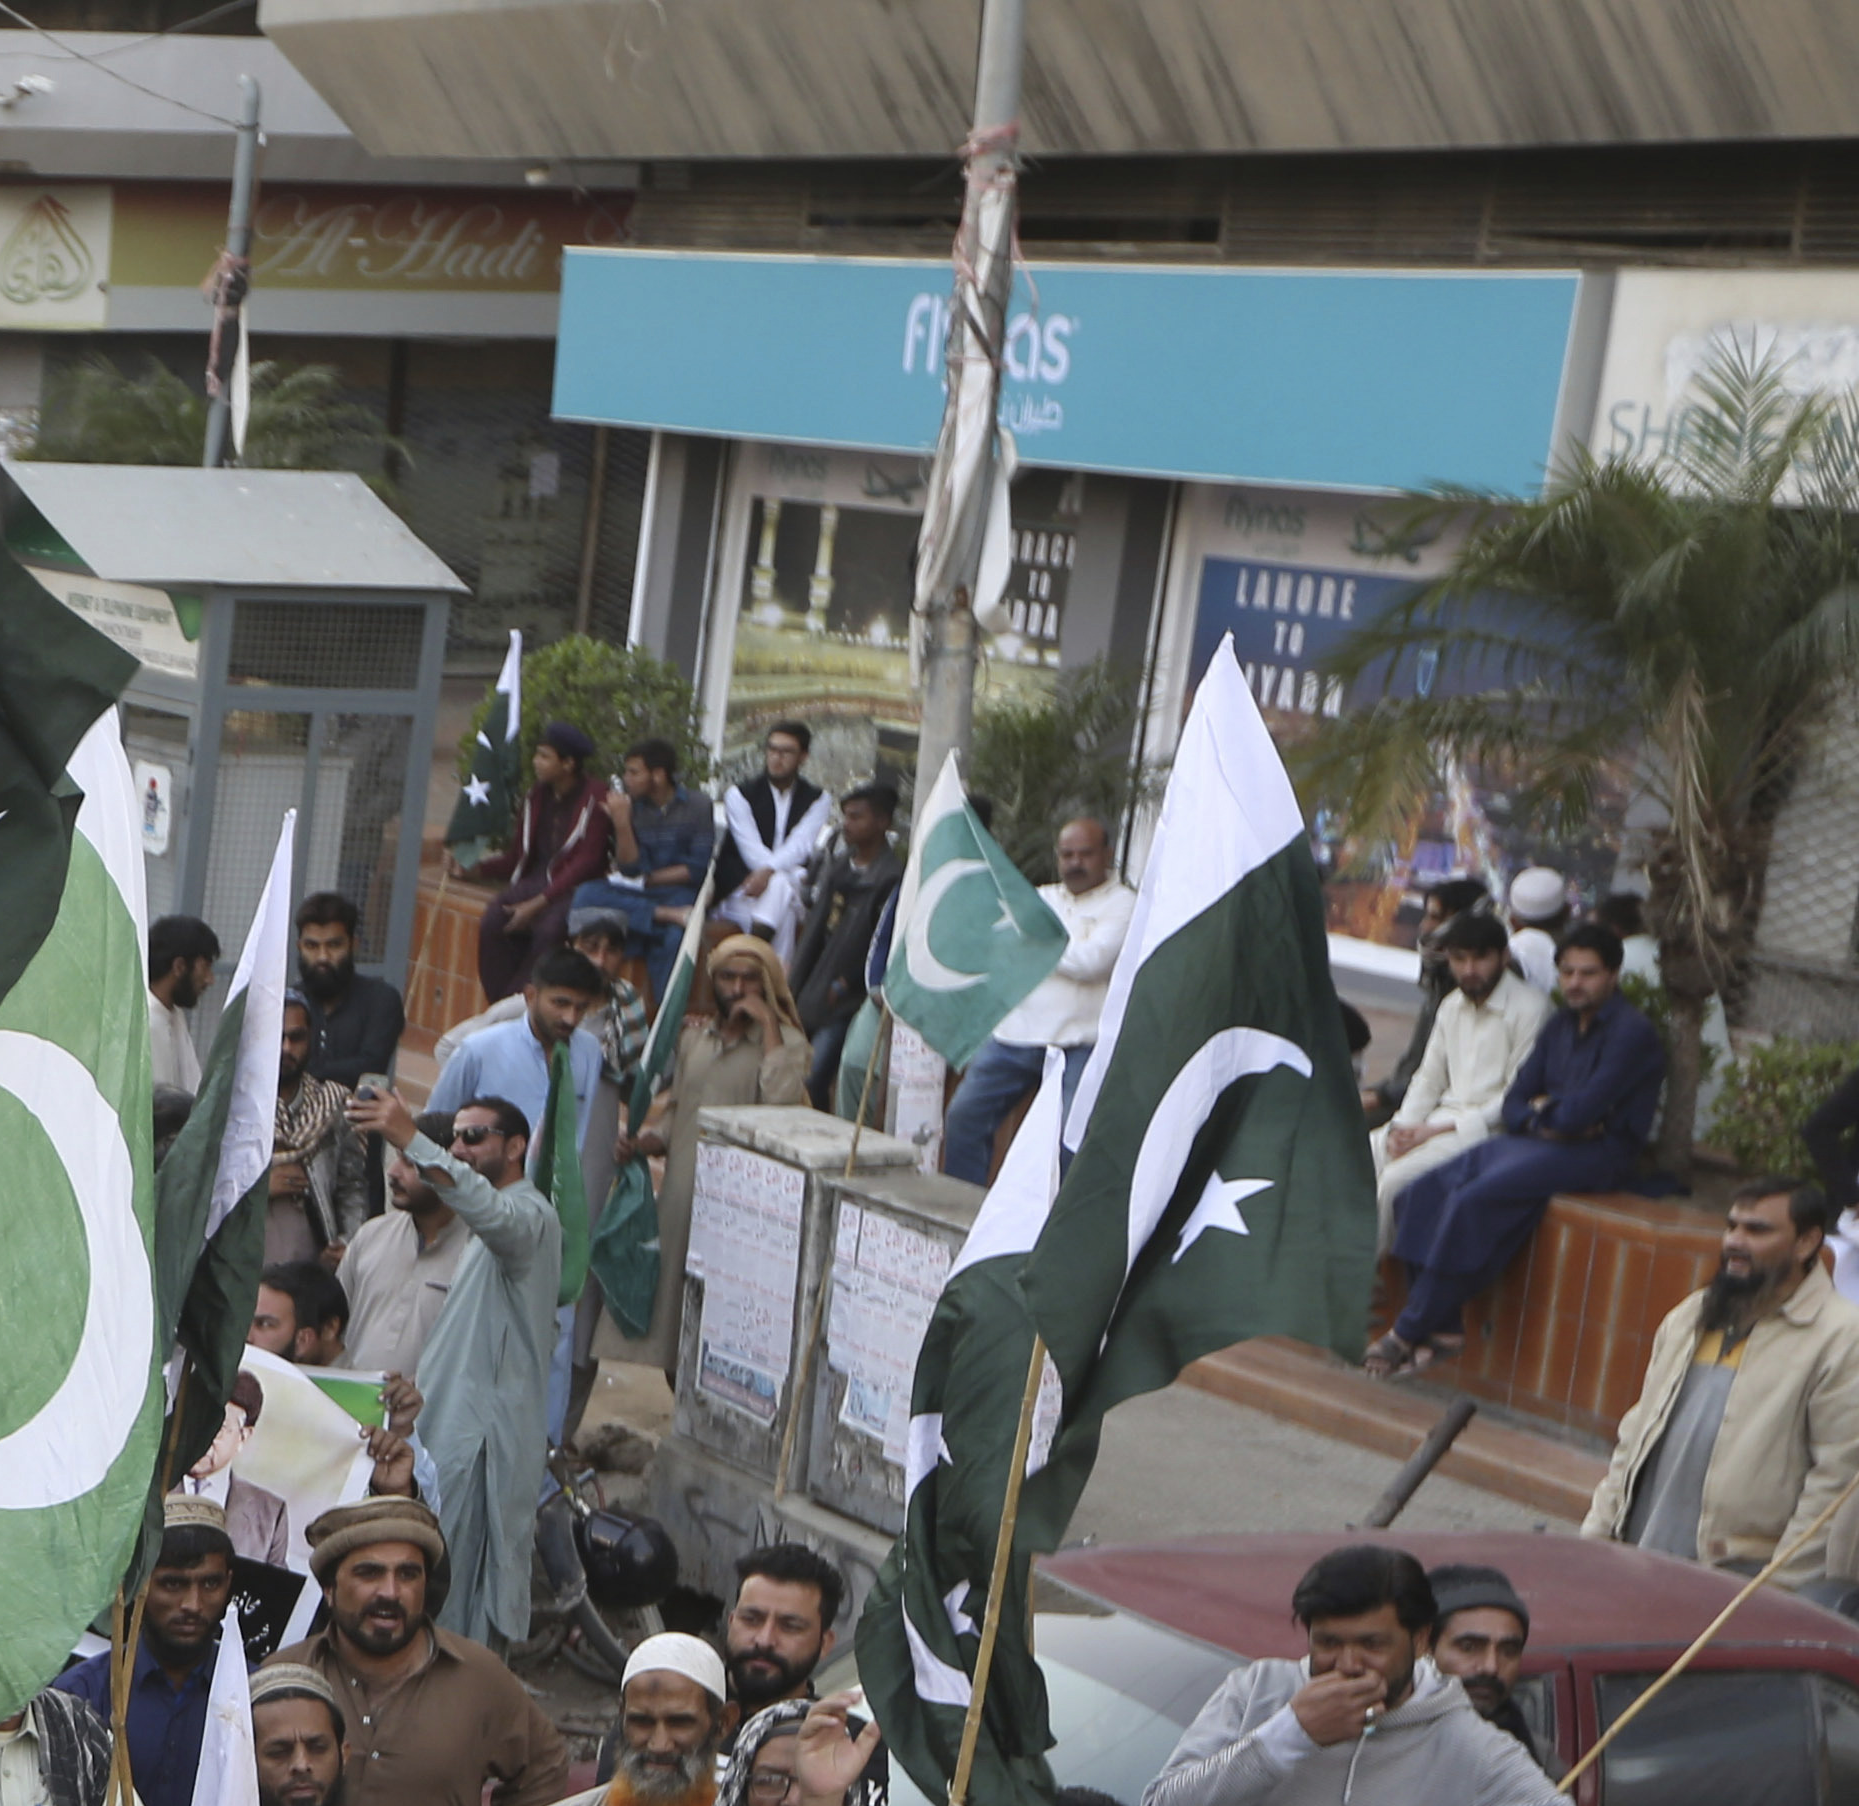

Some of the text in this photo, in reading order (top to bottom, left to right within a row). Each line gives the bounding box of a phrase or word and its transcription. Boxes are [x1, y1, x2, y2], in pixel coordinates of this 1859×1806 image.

[902, 292, 1071, 384] flas
[1235, 567, 1357, 621] LAHORE
[1273, 620, 1305, 658] TO
